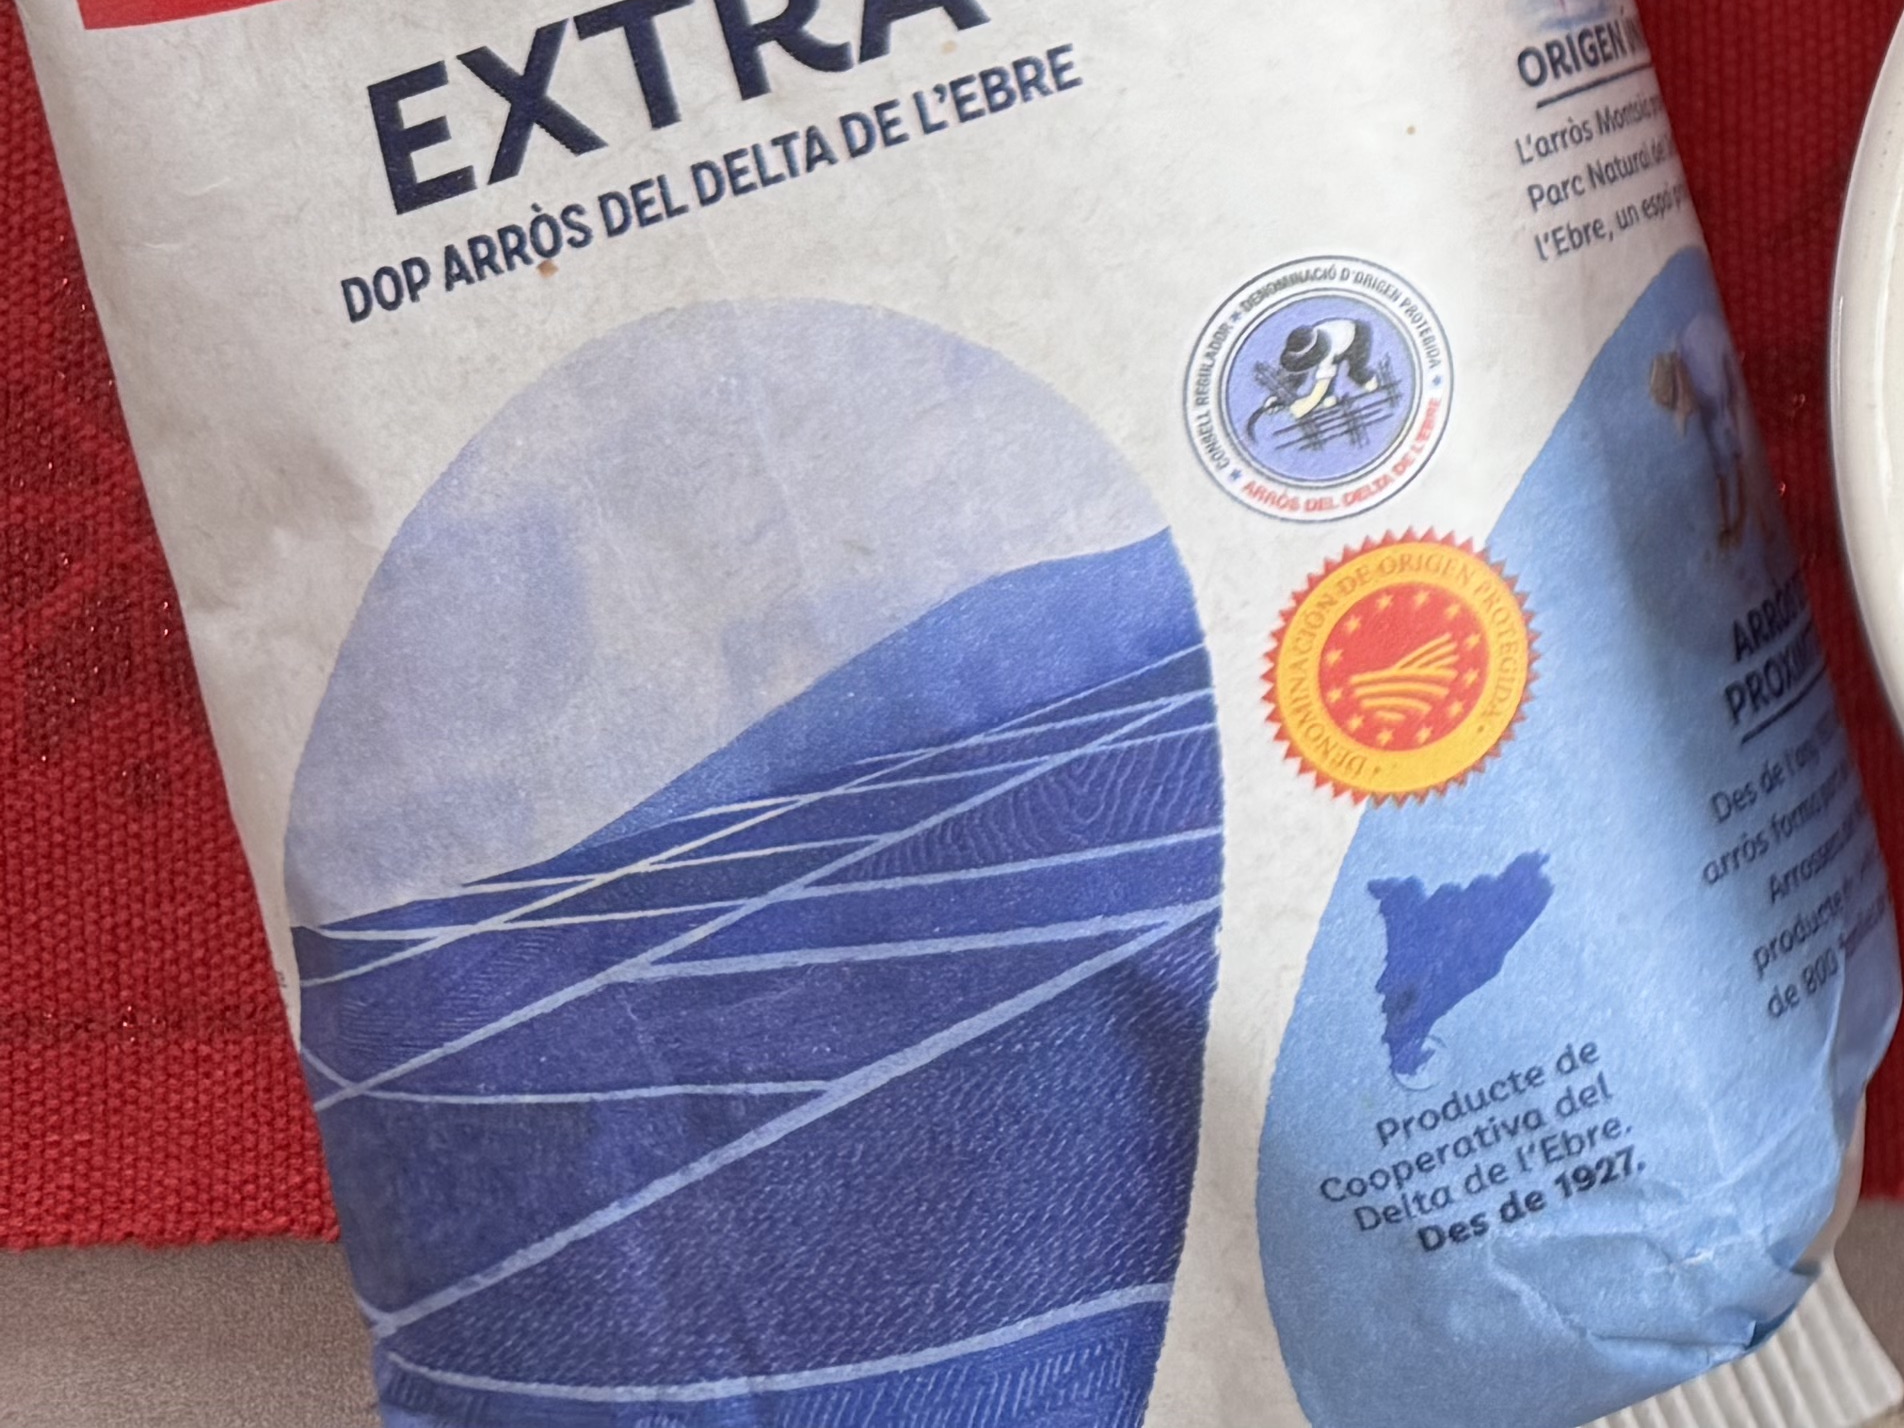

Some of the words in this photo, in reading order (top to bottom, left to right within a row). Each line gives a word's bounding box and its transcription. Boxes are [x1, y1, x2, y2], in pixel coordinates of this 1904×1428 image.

[1517, 19, 1627, 87] ORIGEN
[1515, 116, 1593, 165] L'arròs
[340, 255, 432, 324] DOP
[442, 203, 595, 291] ARRÒS
[597, 173, 689, 239] DEL
[690, 125, 838, 208] DELTA
[839, 98, 909, 159] DE
[912, 43, 1084, 135] L'EBRE
[1527, 172, 1585, 212] Parc
[1616, 205, 1640, 230] un
[1304, 496, 1340, 513] DEL
[1340, 472, 1395, 508] DELTA
[1391, 453, 1416, 477] DE
[1337, 567, 1371, 598] DE
[1380, 552, 1477, 590] ORIGEN
[1474, 582, 1520, 719] PROTEGIDA
[1711, 779, 1757, 825] Des
[1759, 761, 1786, 797] de
[1701, 827, 1769, 884] arròs
[1767, 983, 1800, 1020] de
[1801, 948, 1839, 995] 800
[1376, 1063, 1545, 1147] Producte
[1555, 1041, 1600, 1076] de
[1319, 1109, 1545, 1203] Cooperativa
[1555, 1071, 1613, 1119] del
[1353, 1185, 1454, 1231] Delta
[1464, 1161, 1509, 1195] de
[1416, 1211, 1490, 1253] Des
[1499, 1188, 1547, 1224] de
[1554, 1144, 1647, 1199] 1927.
